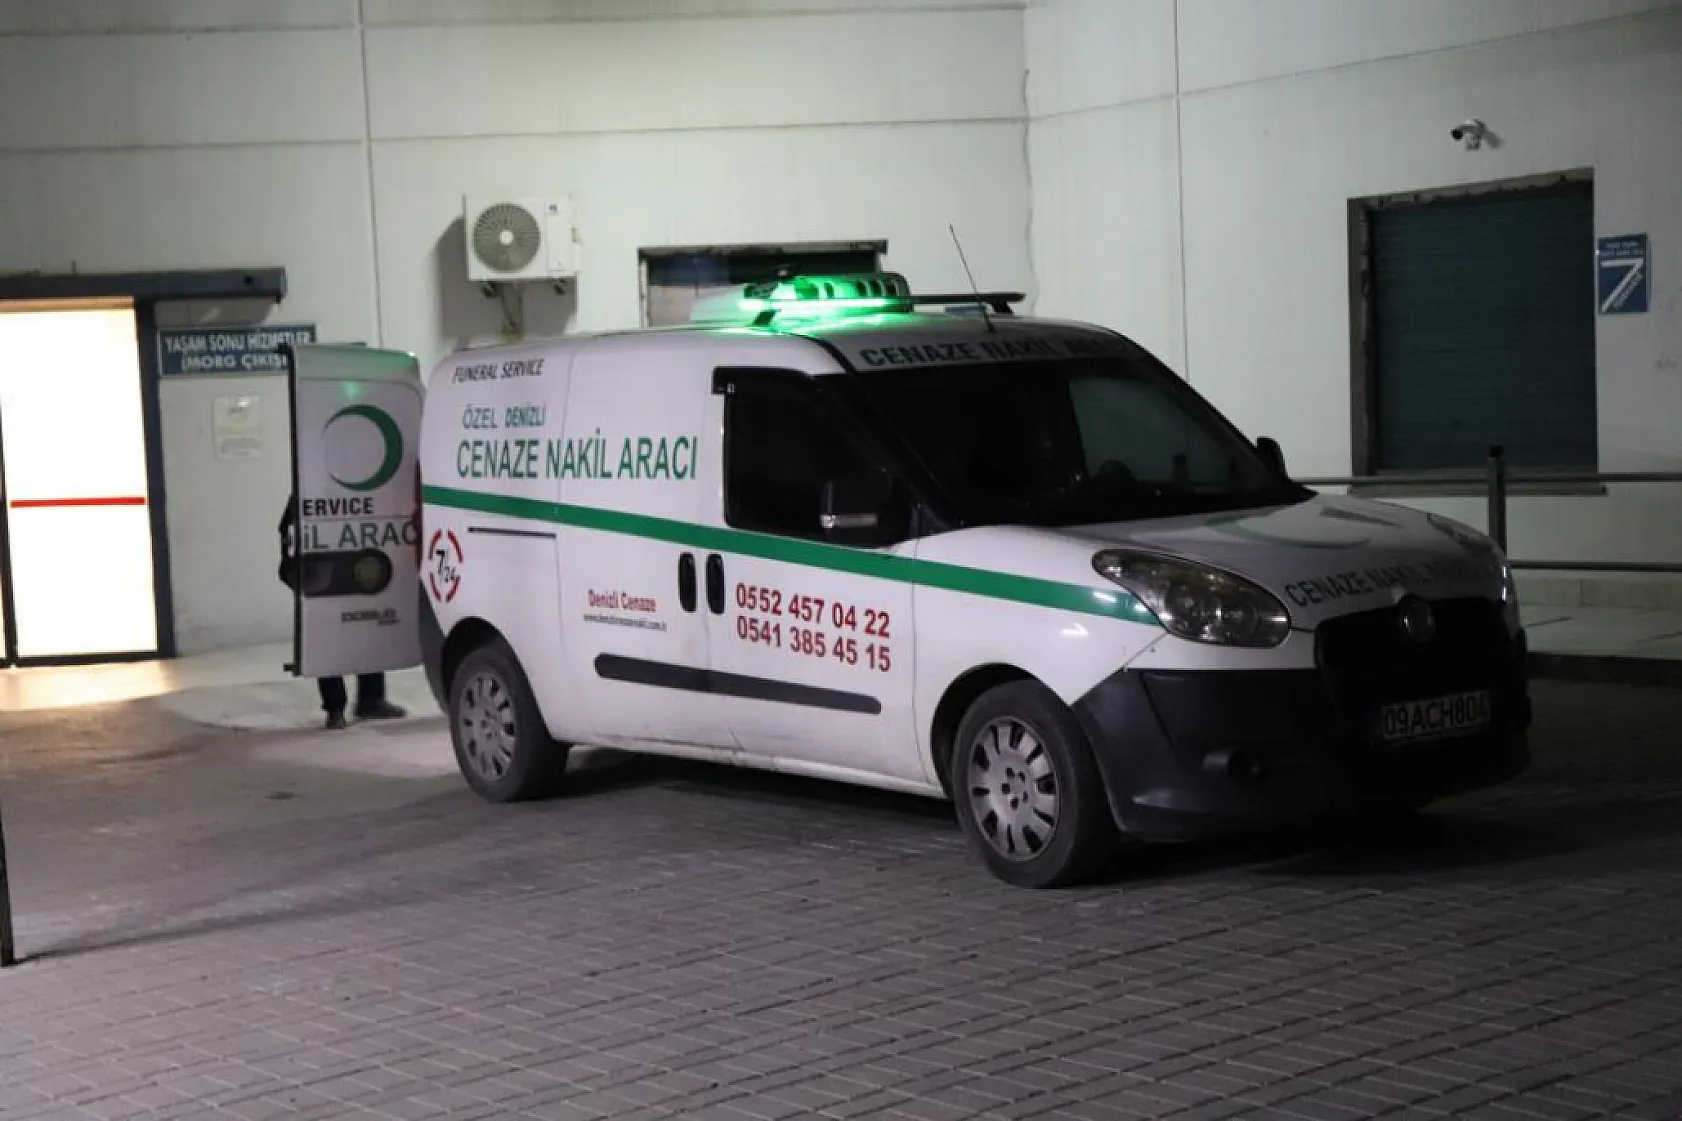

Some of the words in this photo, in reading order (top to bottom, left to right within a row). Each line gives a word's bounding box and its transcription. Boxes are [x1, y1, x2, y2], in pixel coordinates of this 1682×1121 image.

[209, 334, 245, 351] SONU
[859, 342, 980, 366] CENAZE
[453, 364, 498, 384] FUNERAL
[501, 358, 546, 379] SERVICE
[463, 403, 498, 429] ÖZEL
[457, 439, 540, 479] CENAZE
[546, 428, 613, 479] NAKİL
[617, 435, 698, 480] ARACI
[303, 496, 375, 517] ERVICE
[1284, 571, 1375, 607] CENAZE
[735, 582, 783, 616] 0552
[788, 592, 825, 624] 457
[831, 602, 858, 631] 04
[864, 609, 890, 638] 22
[736, 615, 783, 648] 0541
[789, 626, 826, 658] 385
[832, 636, 859, 666] 45
[865, 643, 891, 672] 15
